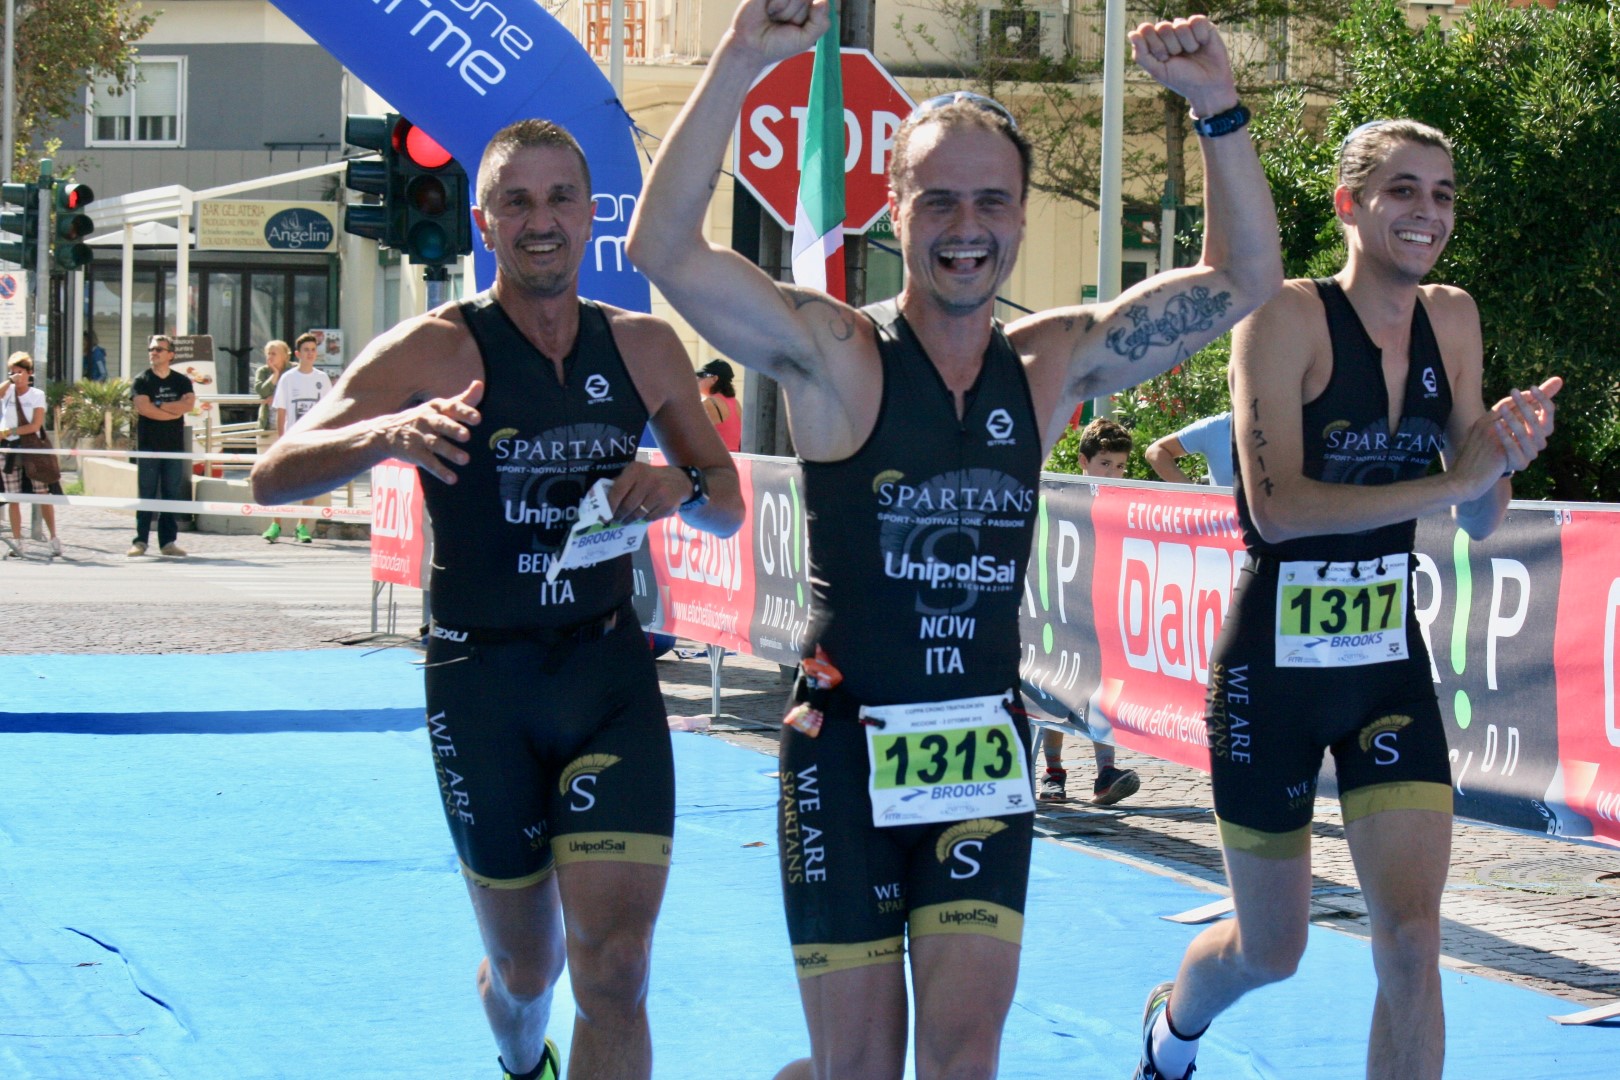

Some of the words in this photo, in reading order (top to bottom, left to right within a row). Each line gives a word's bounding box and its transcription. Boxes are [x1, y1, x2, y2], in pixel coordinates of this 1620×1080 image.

[222, 203, 266, 217] GELATERIA
[267, 222, 331, 249] Angelini
[495, 434, 637, 460] SPARTANS
[878, 482, 1034, 513] SPARTANS
[505, 499, 582, 530] Unipo
[1127, 502, 1242, 540] ETICHETTIFIC
[577, 528, 624, 549] BROOKS
[884, 551, 1016, 589] UnipolSai
[541, 579, 575, 606] ITA
[1118, 537, 1247, 684] Dan
[1291, 582, 1397, 634] 1317
[433, 625, 469, 643] 2XU
[919, 615, 976, 639] NOVI
[1330, 632, 1384, 648] BROOKS
[925, 647, 965, 676] ITA
[1227, 664, 1249, 705] WE
[1229, 713, 1250, 765] ARE
[429, 710, 457, 757] WE
[445, 767, 475, 825] ARE
[885, 728, 1013, 785] 1313
[797, 764, 821, 814] WE
[931, 782, 996, 800] BROOKS
[781, 771, 804, 884] SPARTANS
[569, 839, 626, 854] UnipolSai
[801, 825, 827, 884] ARE
[874, 882, 900, 901] WE
[939, 908, 999, 926] UnipolSai
